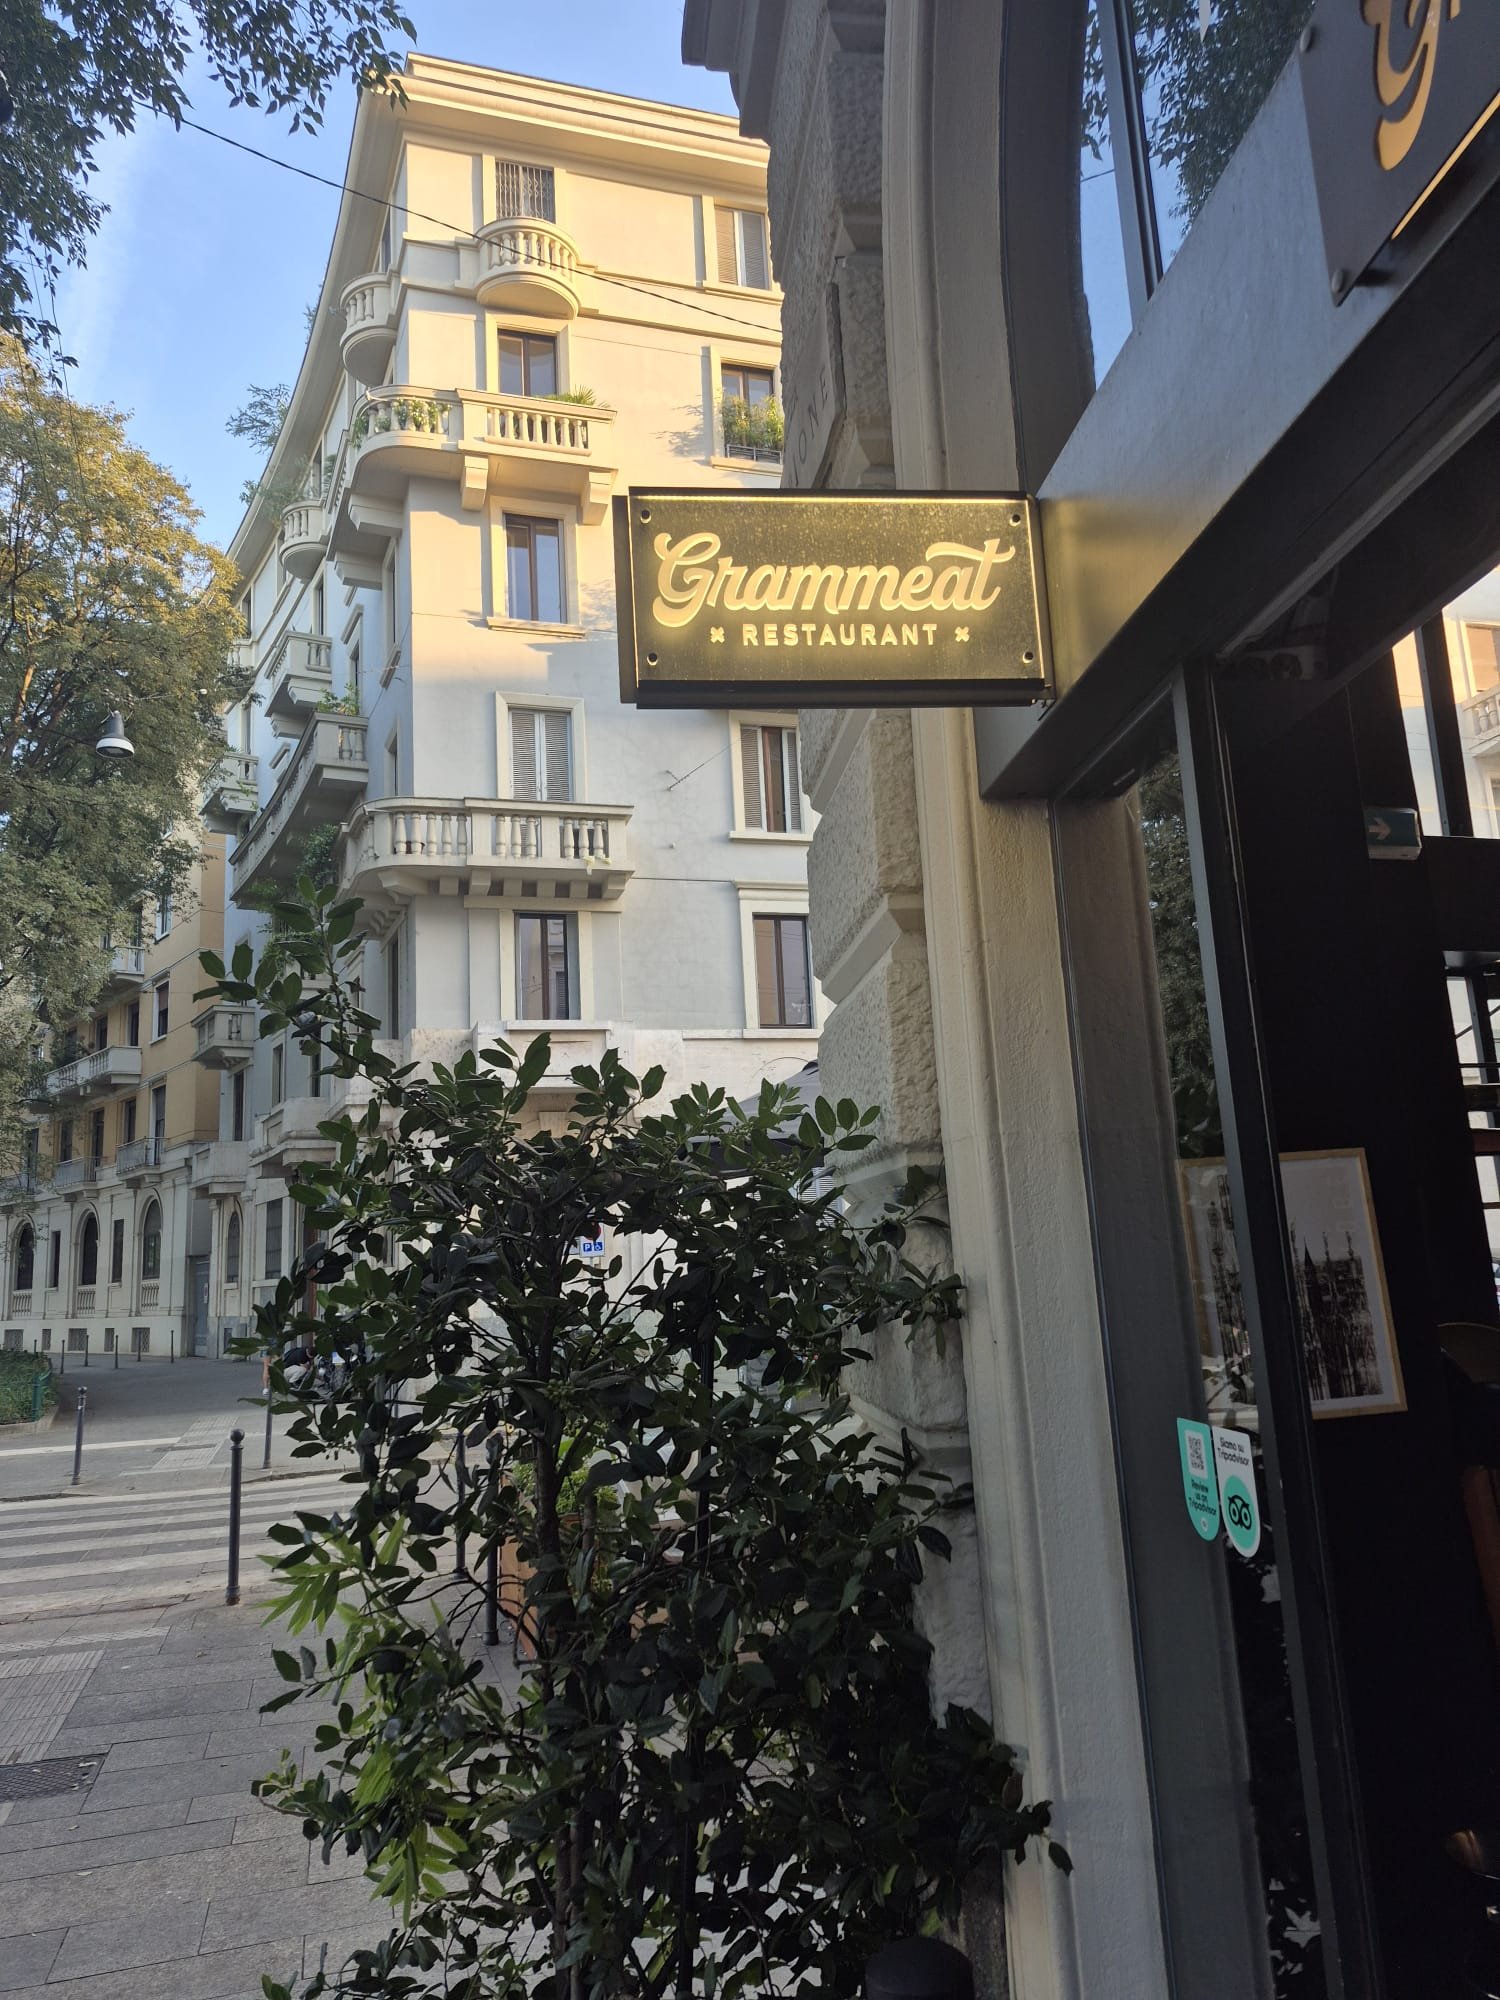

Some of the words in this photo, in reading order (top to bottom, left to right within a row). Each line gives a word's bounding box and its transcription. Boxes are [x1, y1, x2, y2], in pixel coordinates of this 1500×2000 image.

[652, 532, 1016, 628] Grammeat
[742, 623, 938, 647] RESTAURANT
[1219, 1437, 1237, 1450] Siamo
[1237, 1444, 1245, 1453] su
[1217, 1448, 1250, 1466] Tripadvisor
[1191, 1479, 1209, 1493] Review
[1188, 1496, 1217, 1516] Tripadvisor
